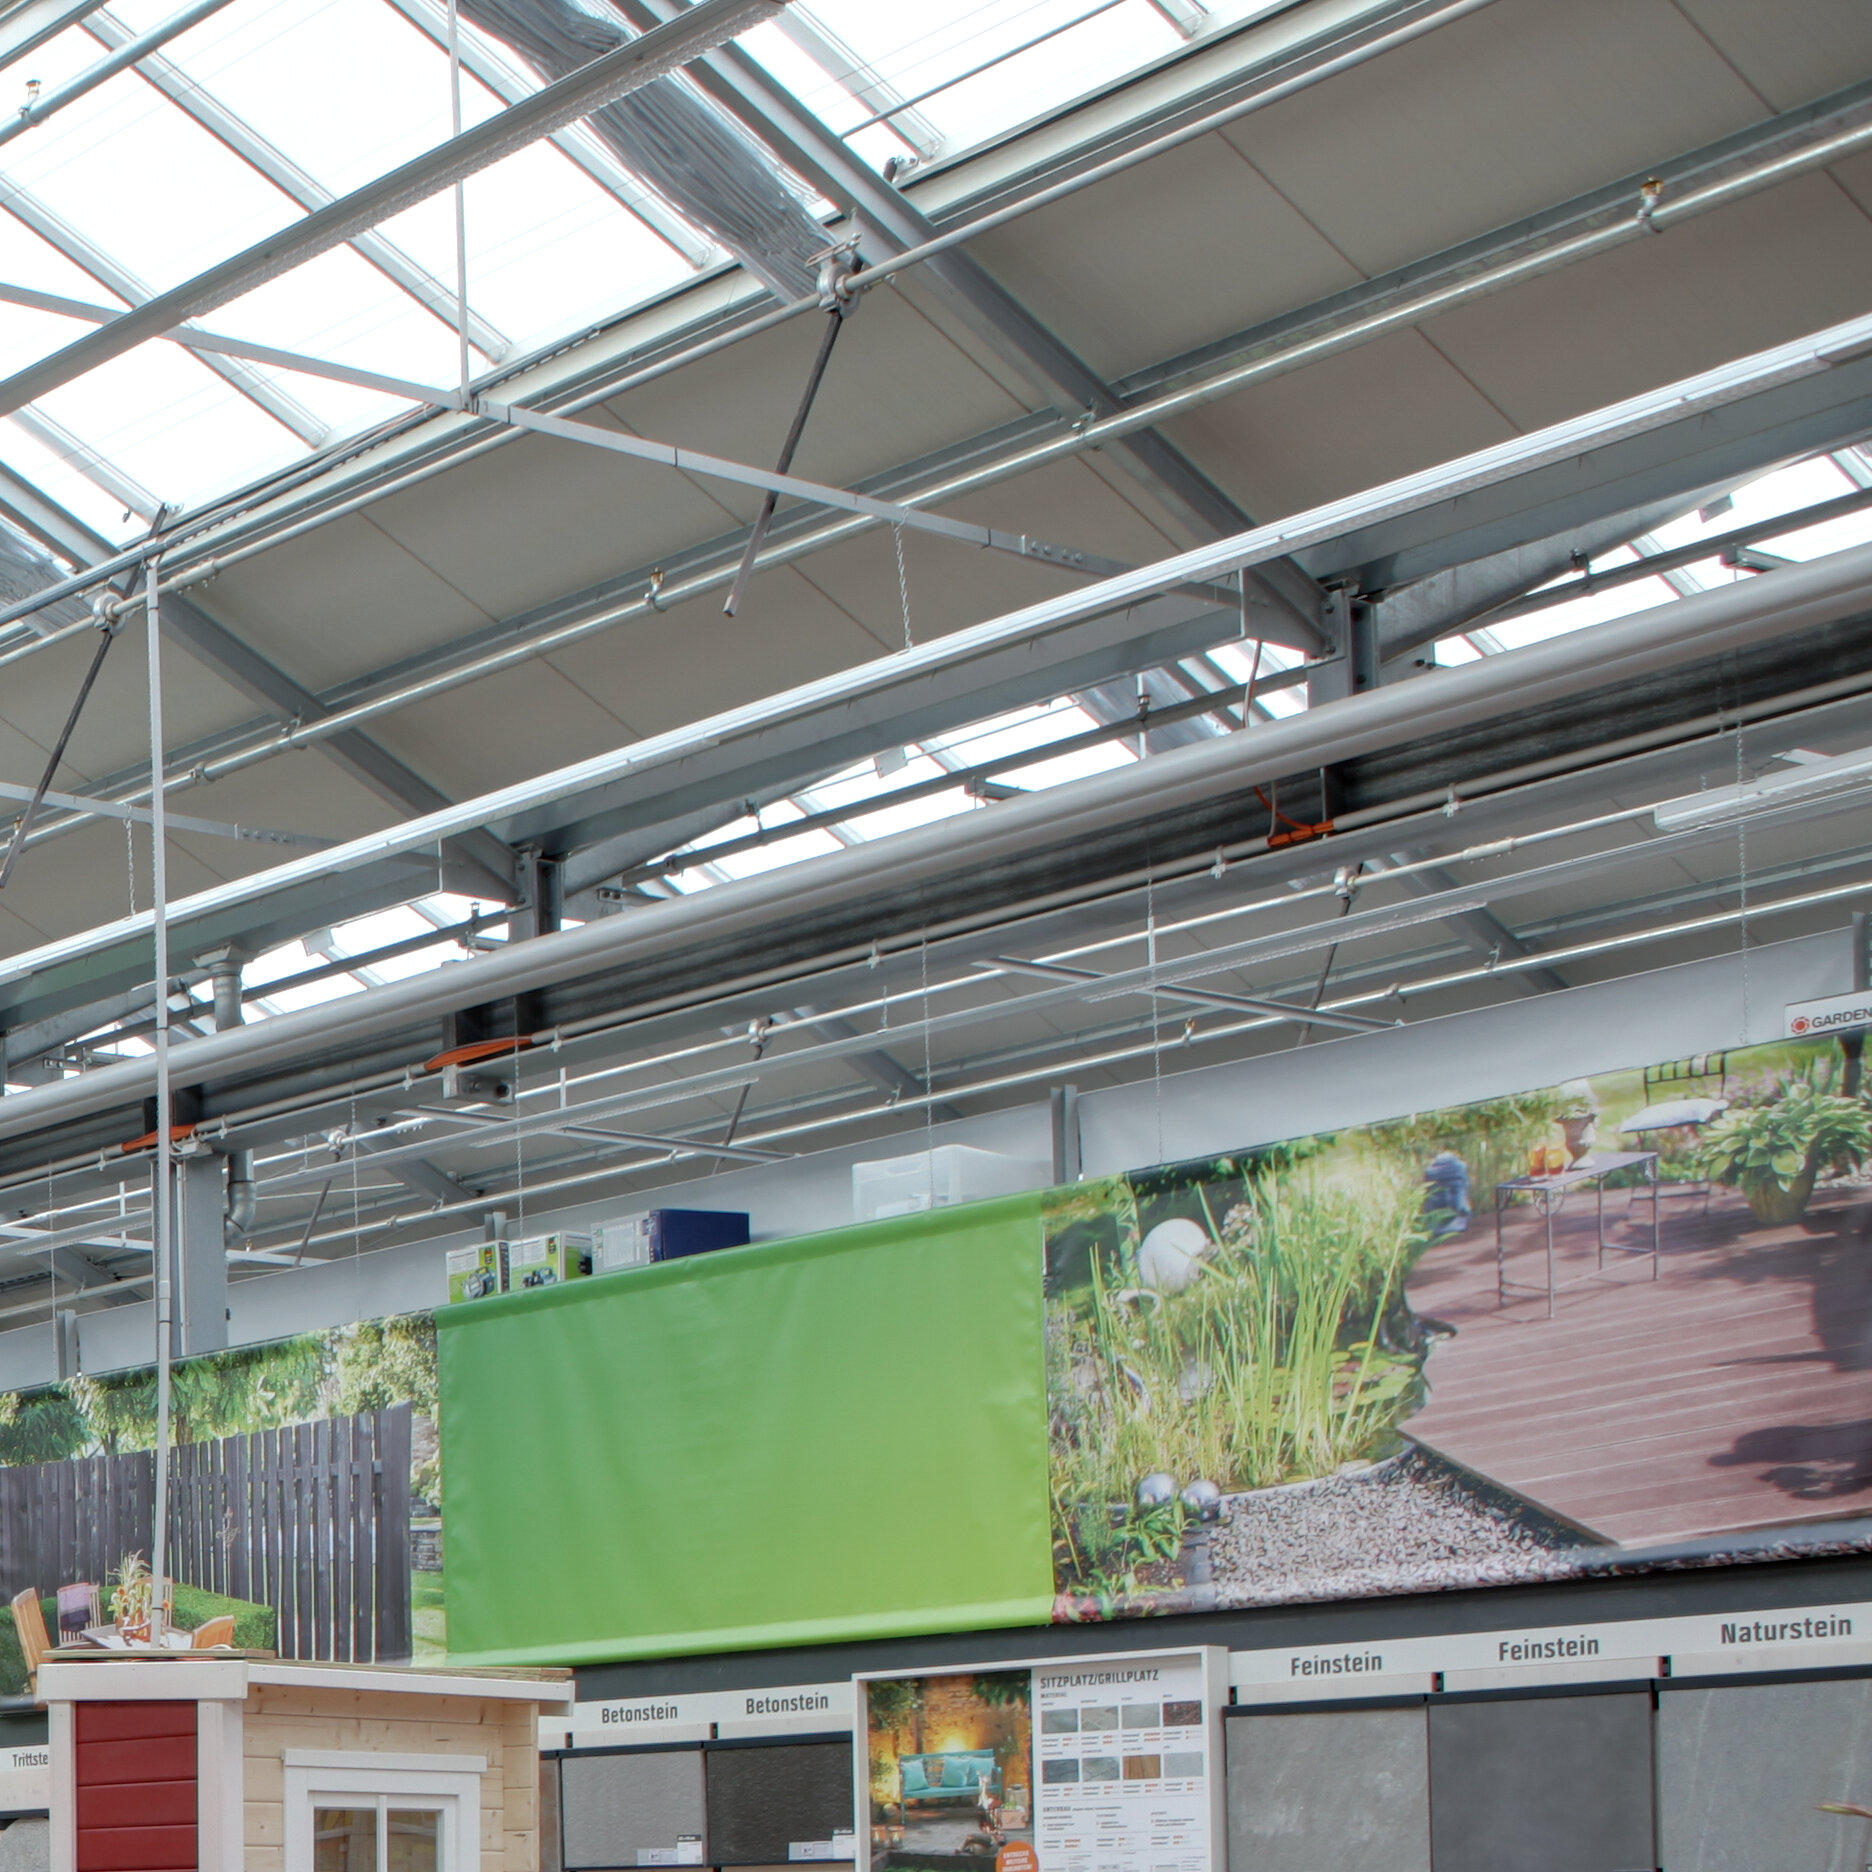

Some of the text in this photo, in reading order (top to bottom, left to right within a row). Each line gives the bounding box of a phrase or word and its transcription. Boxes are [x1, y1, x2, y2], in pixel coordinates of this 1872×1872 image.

[1721, 1616, 1852, 1645] Naturstein
[1499, 1636, 1600, 1661] Feinstein
[1290, 1653, 1383, 1676] Feinstein
[1040, 1669, 1159, 1689] SITZPLATZ/GRILLPLATZ
[601, 1704, 678, 1723] Betonstein
[746, 1692, 829, 1715] Betonstein
[12, 1752, 48, 1768] Trittste
